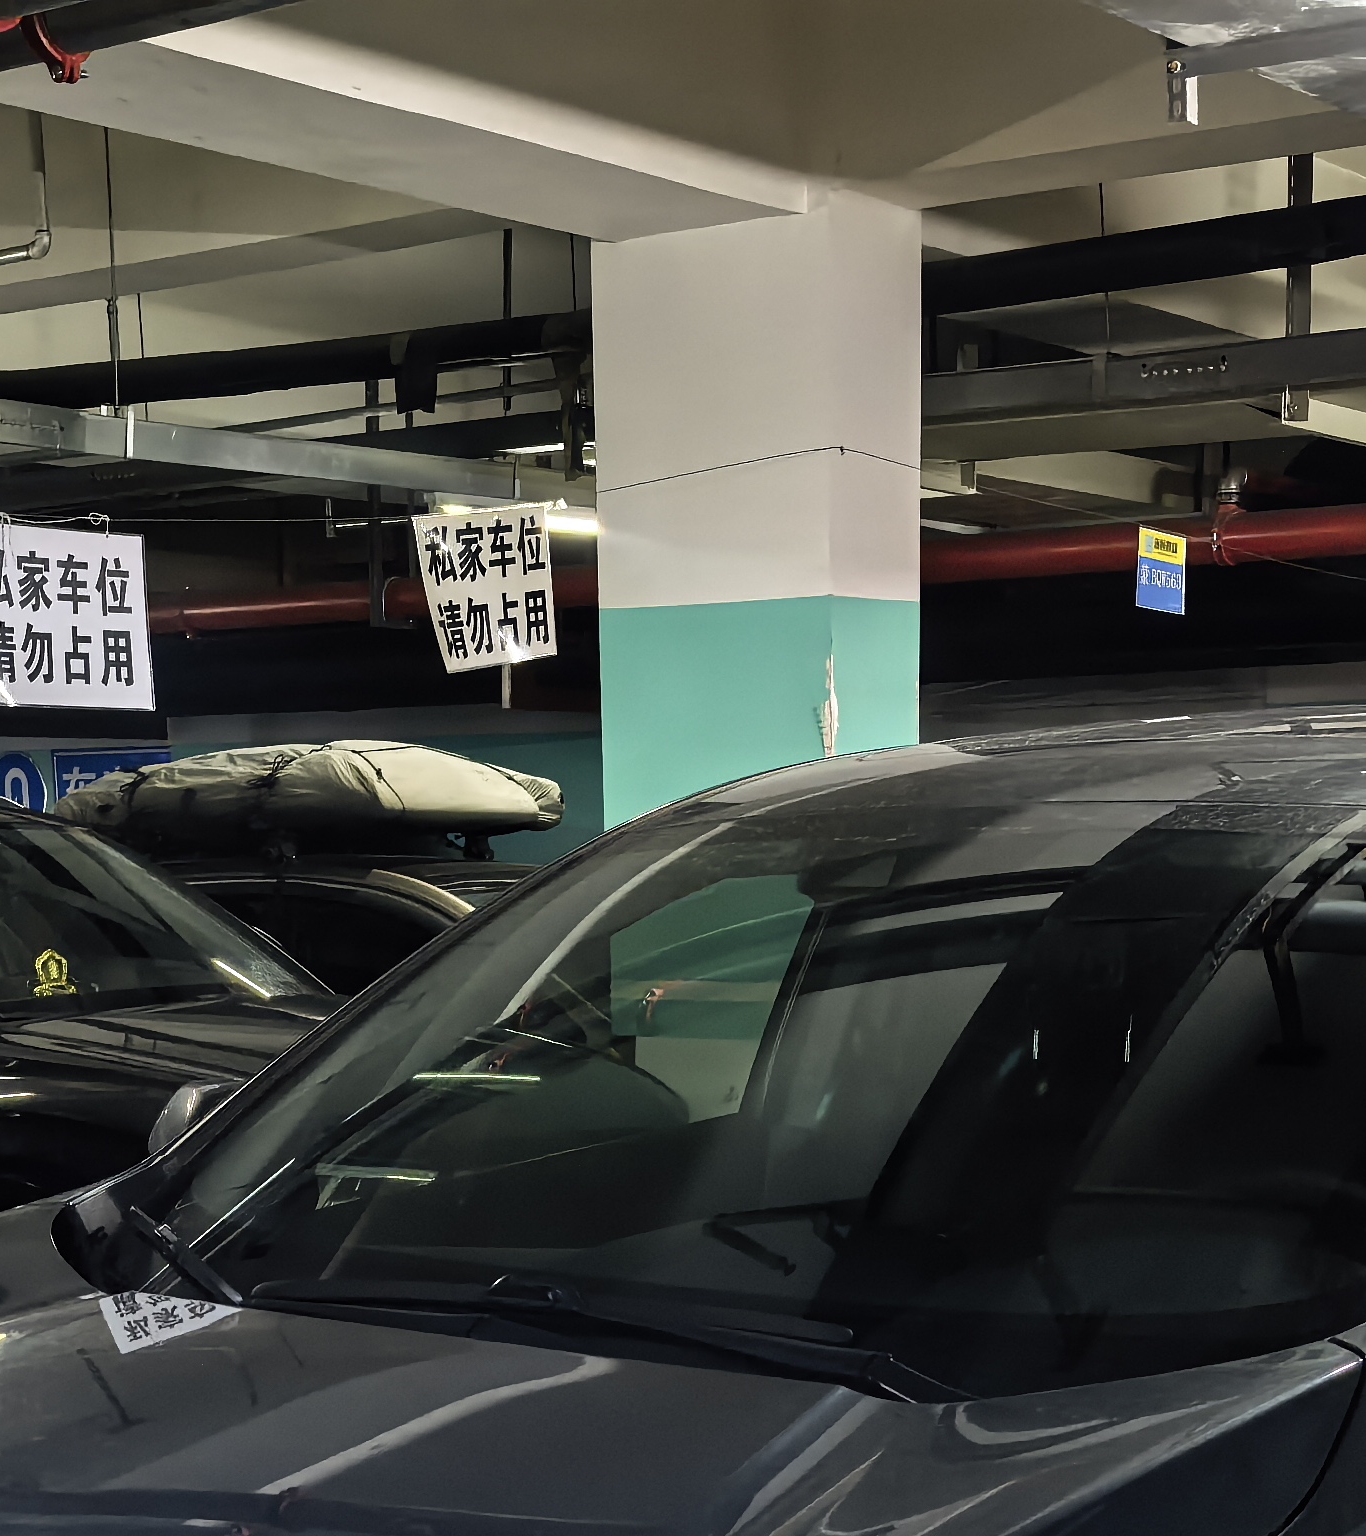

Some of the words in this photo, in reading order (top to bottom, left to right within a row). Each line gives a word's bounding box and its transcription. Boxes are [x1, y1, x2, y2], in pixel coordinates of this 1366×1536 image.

[425, 515, 546, 586] 私家车位
[438, 590, 550, 659] 请勿占用
